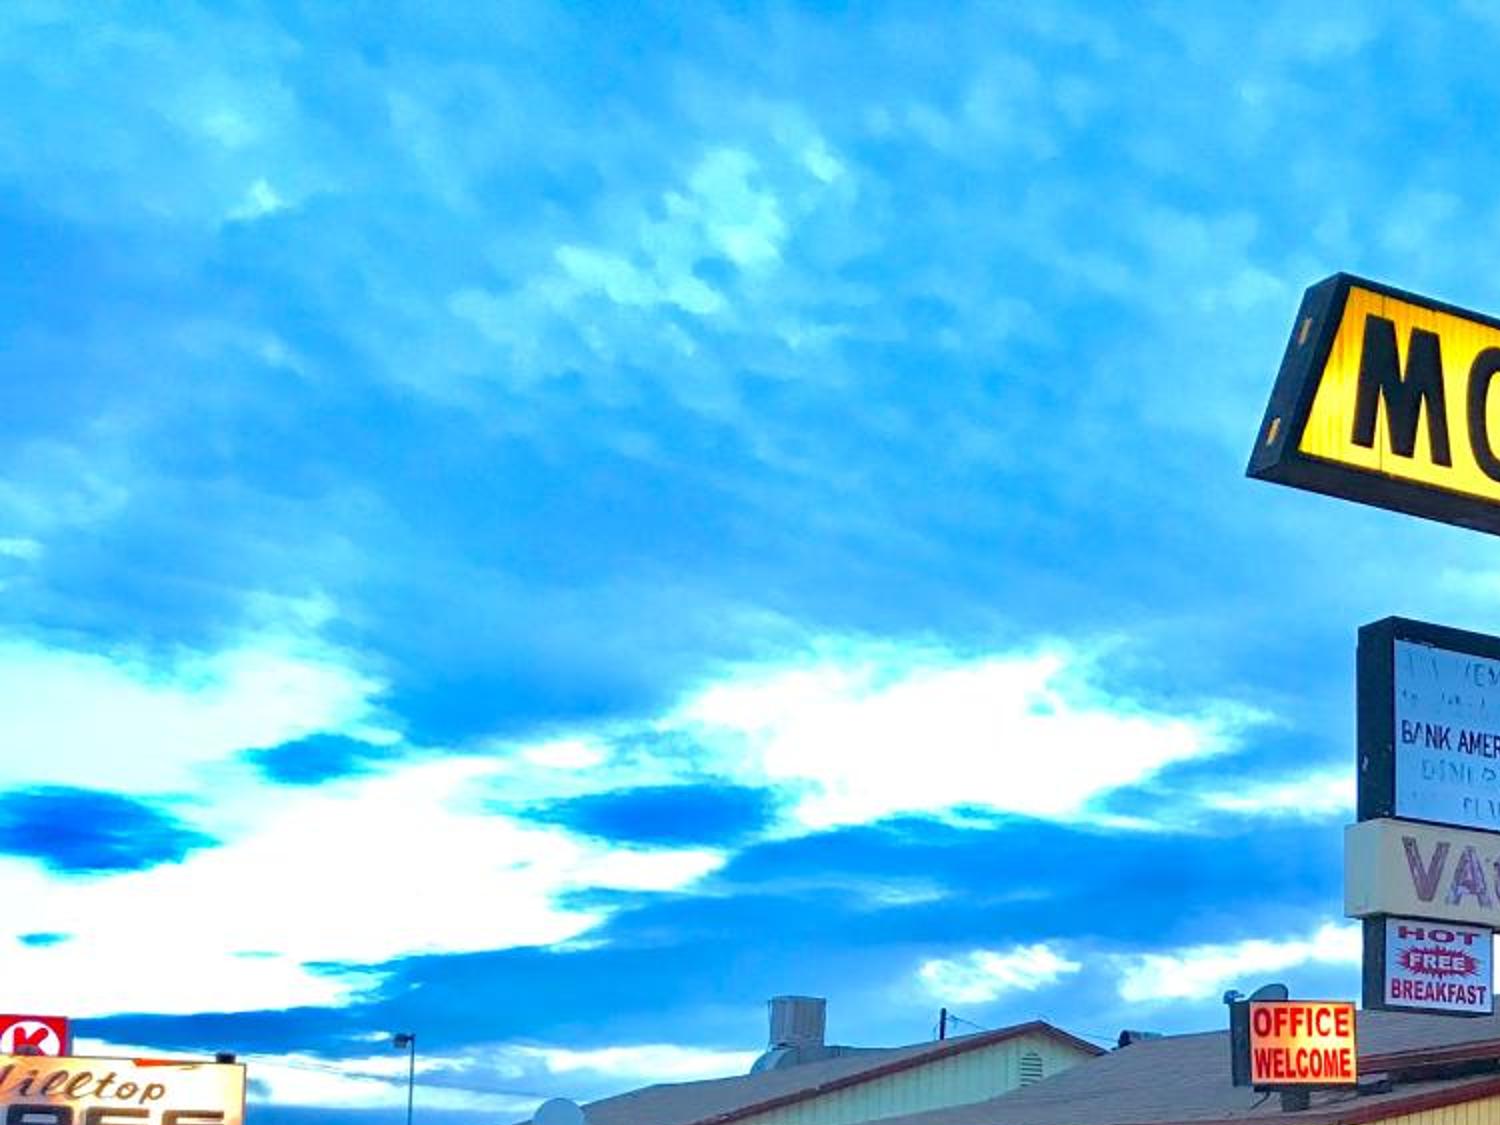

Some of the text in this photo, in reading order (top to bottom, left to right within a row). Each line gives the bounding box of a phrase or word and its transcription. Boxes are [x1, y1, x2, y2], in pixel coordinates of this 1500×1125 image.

[1401, 719, 1452, 751] BANK
[1398, 925, 1481, 946] HOT
[1407, 954, 1467, 972] FREE
[1390, 976, 1487, 1007] BREAKFAST
[1253, 1007, 1350, 1038] OFFICE
[13, 1026, 49, 1055] K
[1254, 1047, 1352, 1079] WELCOME
